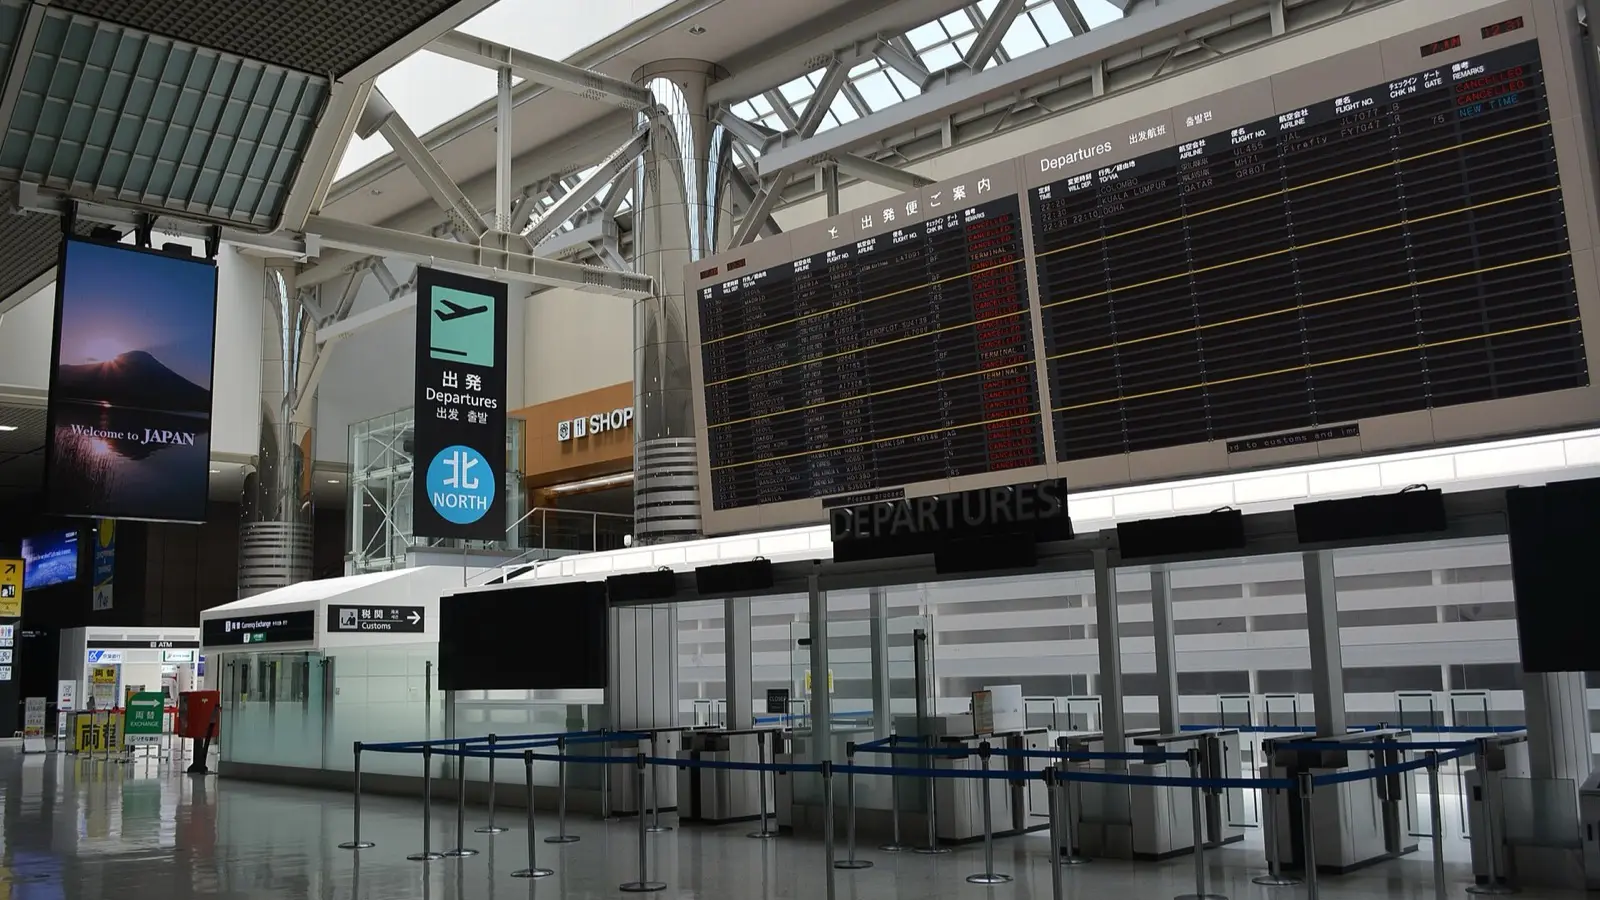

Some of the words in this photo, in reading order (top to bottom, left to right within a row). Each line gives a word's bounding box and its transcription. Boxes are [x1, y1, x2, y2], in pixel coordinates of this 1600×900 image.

[1178, 138, 1205, 152] 航空会社
[1230, 126, 1244, 137] 便名
[1278, 108, 1308, 123] 航空会社
[1334, 95, 1350, 106] 便名
[1388, 76, 1417, 91] チェックイン
[1423, 69, 1440, 80] ゲート
[1451, 61, 1468, 72] 備考
[1283, 130, 1300, 142] JAL
[1455, 65, 1523, 92] CANCELLED
[1186, 110, 1213, 127] 출발편
[1039, 191, 1051, 200] TIME
[1068, 183, 1080, 192] WILL
[1080, 180, 1092, 189] DEP.
[1099, 172, 1118, 183] TO/VIA
[1179, 147, 1202, 160] AIRLINE
[1231, 132, 1254, 144] FLIGHT
[1255, 129, 1266, 137] NO.
[1279, 117, 1305, 130] AIRLINE
[1335, 101, 1360, 114] FLIGHT
[1361, 97, 1374, 106] NO.
[1389, 88, 1405, 98] CHK
[1407, 85, 1416, 93] IN
[1424, 77, 1442, 88] GATE
[1452, 65, 1484, 80] REMARKS
[1102, 190, 1128, 204] KUALA
[1133, 180, 1166, 195] LUMPUR
[1234, 154, 1258, 167] MH71
[1283, 134, 1327, 154] Firefly
[1456, 78, 1524, 105] CANCELLED
[1129, 124, 1166, 144] 出发航班
[1184, 178, 1212, 192] QATAR
[1235, 163, 1266, 178] QR807
[1431, 114, 1444, 125] 75
[1458, 104, 1481, 117] NEW
[1488, 93, 1518, 109] TIME
[1040, 141, 1112, 172] Departures
[862, 178, 991, 230] 出発便ご案内
[970, 245, 1006, 261] TERMINAL
[980, 346, 1017, 360] TERMINAL
[442, 371, 482, 392] 出発
[982, 366, 1019, 380] TERMINAL
[426, 387, 498, 409] Departures
[436, 408, 460, 422] 出发
[467, 410, 488, 424] 출발
[590, 408, 634, 434] SHOP
[71, 424, 124, 440] Welcome
[127, 432, 138, 441] to
[141, 428, 196, 446] JAPAN
[1264, 434, 1308, 446] customs
[1314, 430, 1333, 440] and
[443, 450, 478, 488] 北
[433, 492, 488, 510] NORTH
[832, 480, 1059, 541] DEPARTURES
[362, 608, 384, 619] 税関
[136, 710, 155, 720] 両替
